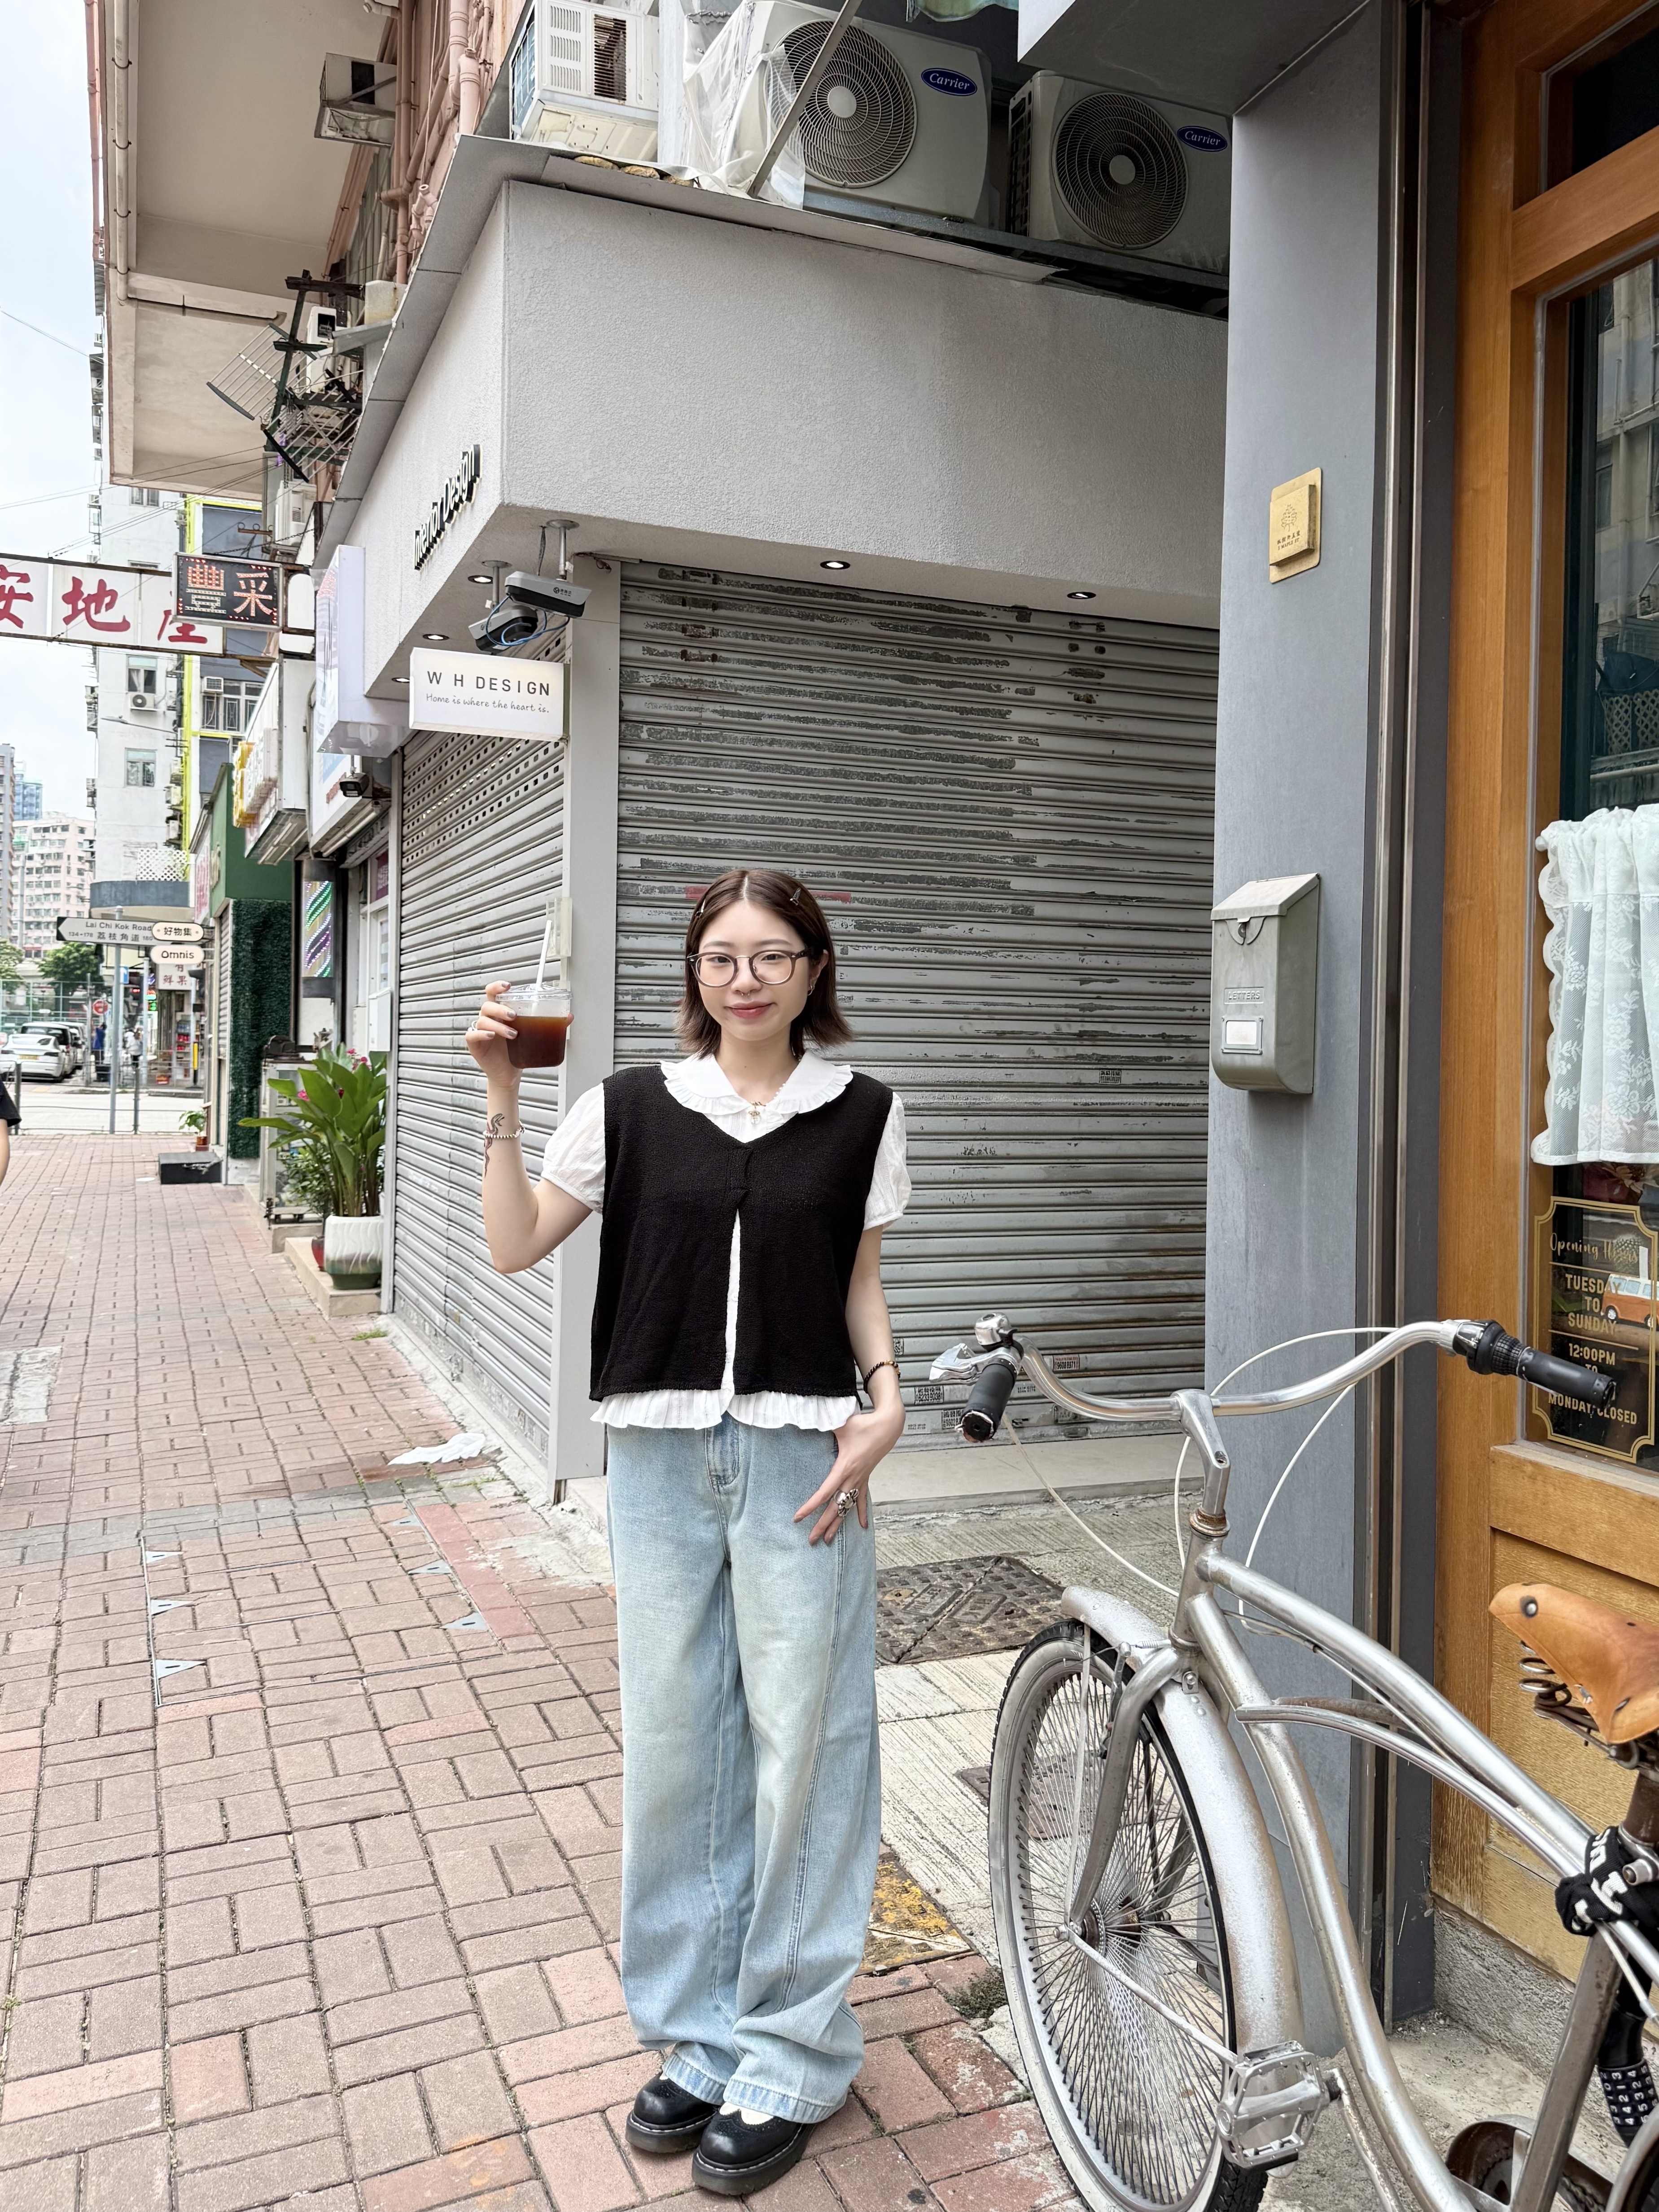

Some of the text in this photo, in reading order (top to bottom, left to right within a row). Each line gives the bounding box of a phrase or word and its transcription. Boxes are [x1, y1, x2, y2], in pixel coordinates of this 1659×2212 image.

[929, 73, 970, 90] Carrier
[1185, 131, 1221, 145] Carrier
[414, 444, 481, 571] Interior Design
[184, 564, 273, 617] 豐采
[427, 671, 549, 696] W H DESIGN
[426, 693, 549, 713] Home is where the heart is.
[97, 932, 139, 942] 荔枝角道
[164, 927, 192, 936] 好物集
[162, 951, 194, 959] Omnis
[1228, 990, 1260, 1000] LETTERS
[1550, 1233, 1598, 1260] Opening
[1565, 1274, 1622, 1295] TUESDAY
[1585, 1296, 1600, 1313] TO
[1568, 1312, 1616, 1336] SUNDAY
[1569, 1343, 1615, 1366] 12:00PM
